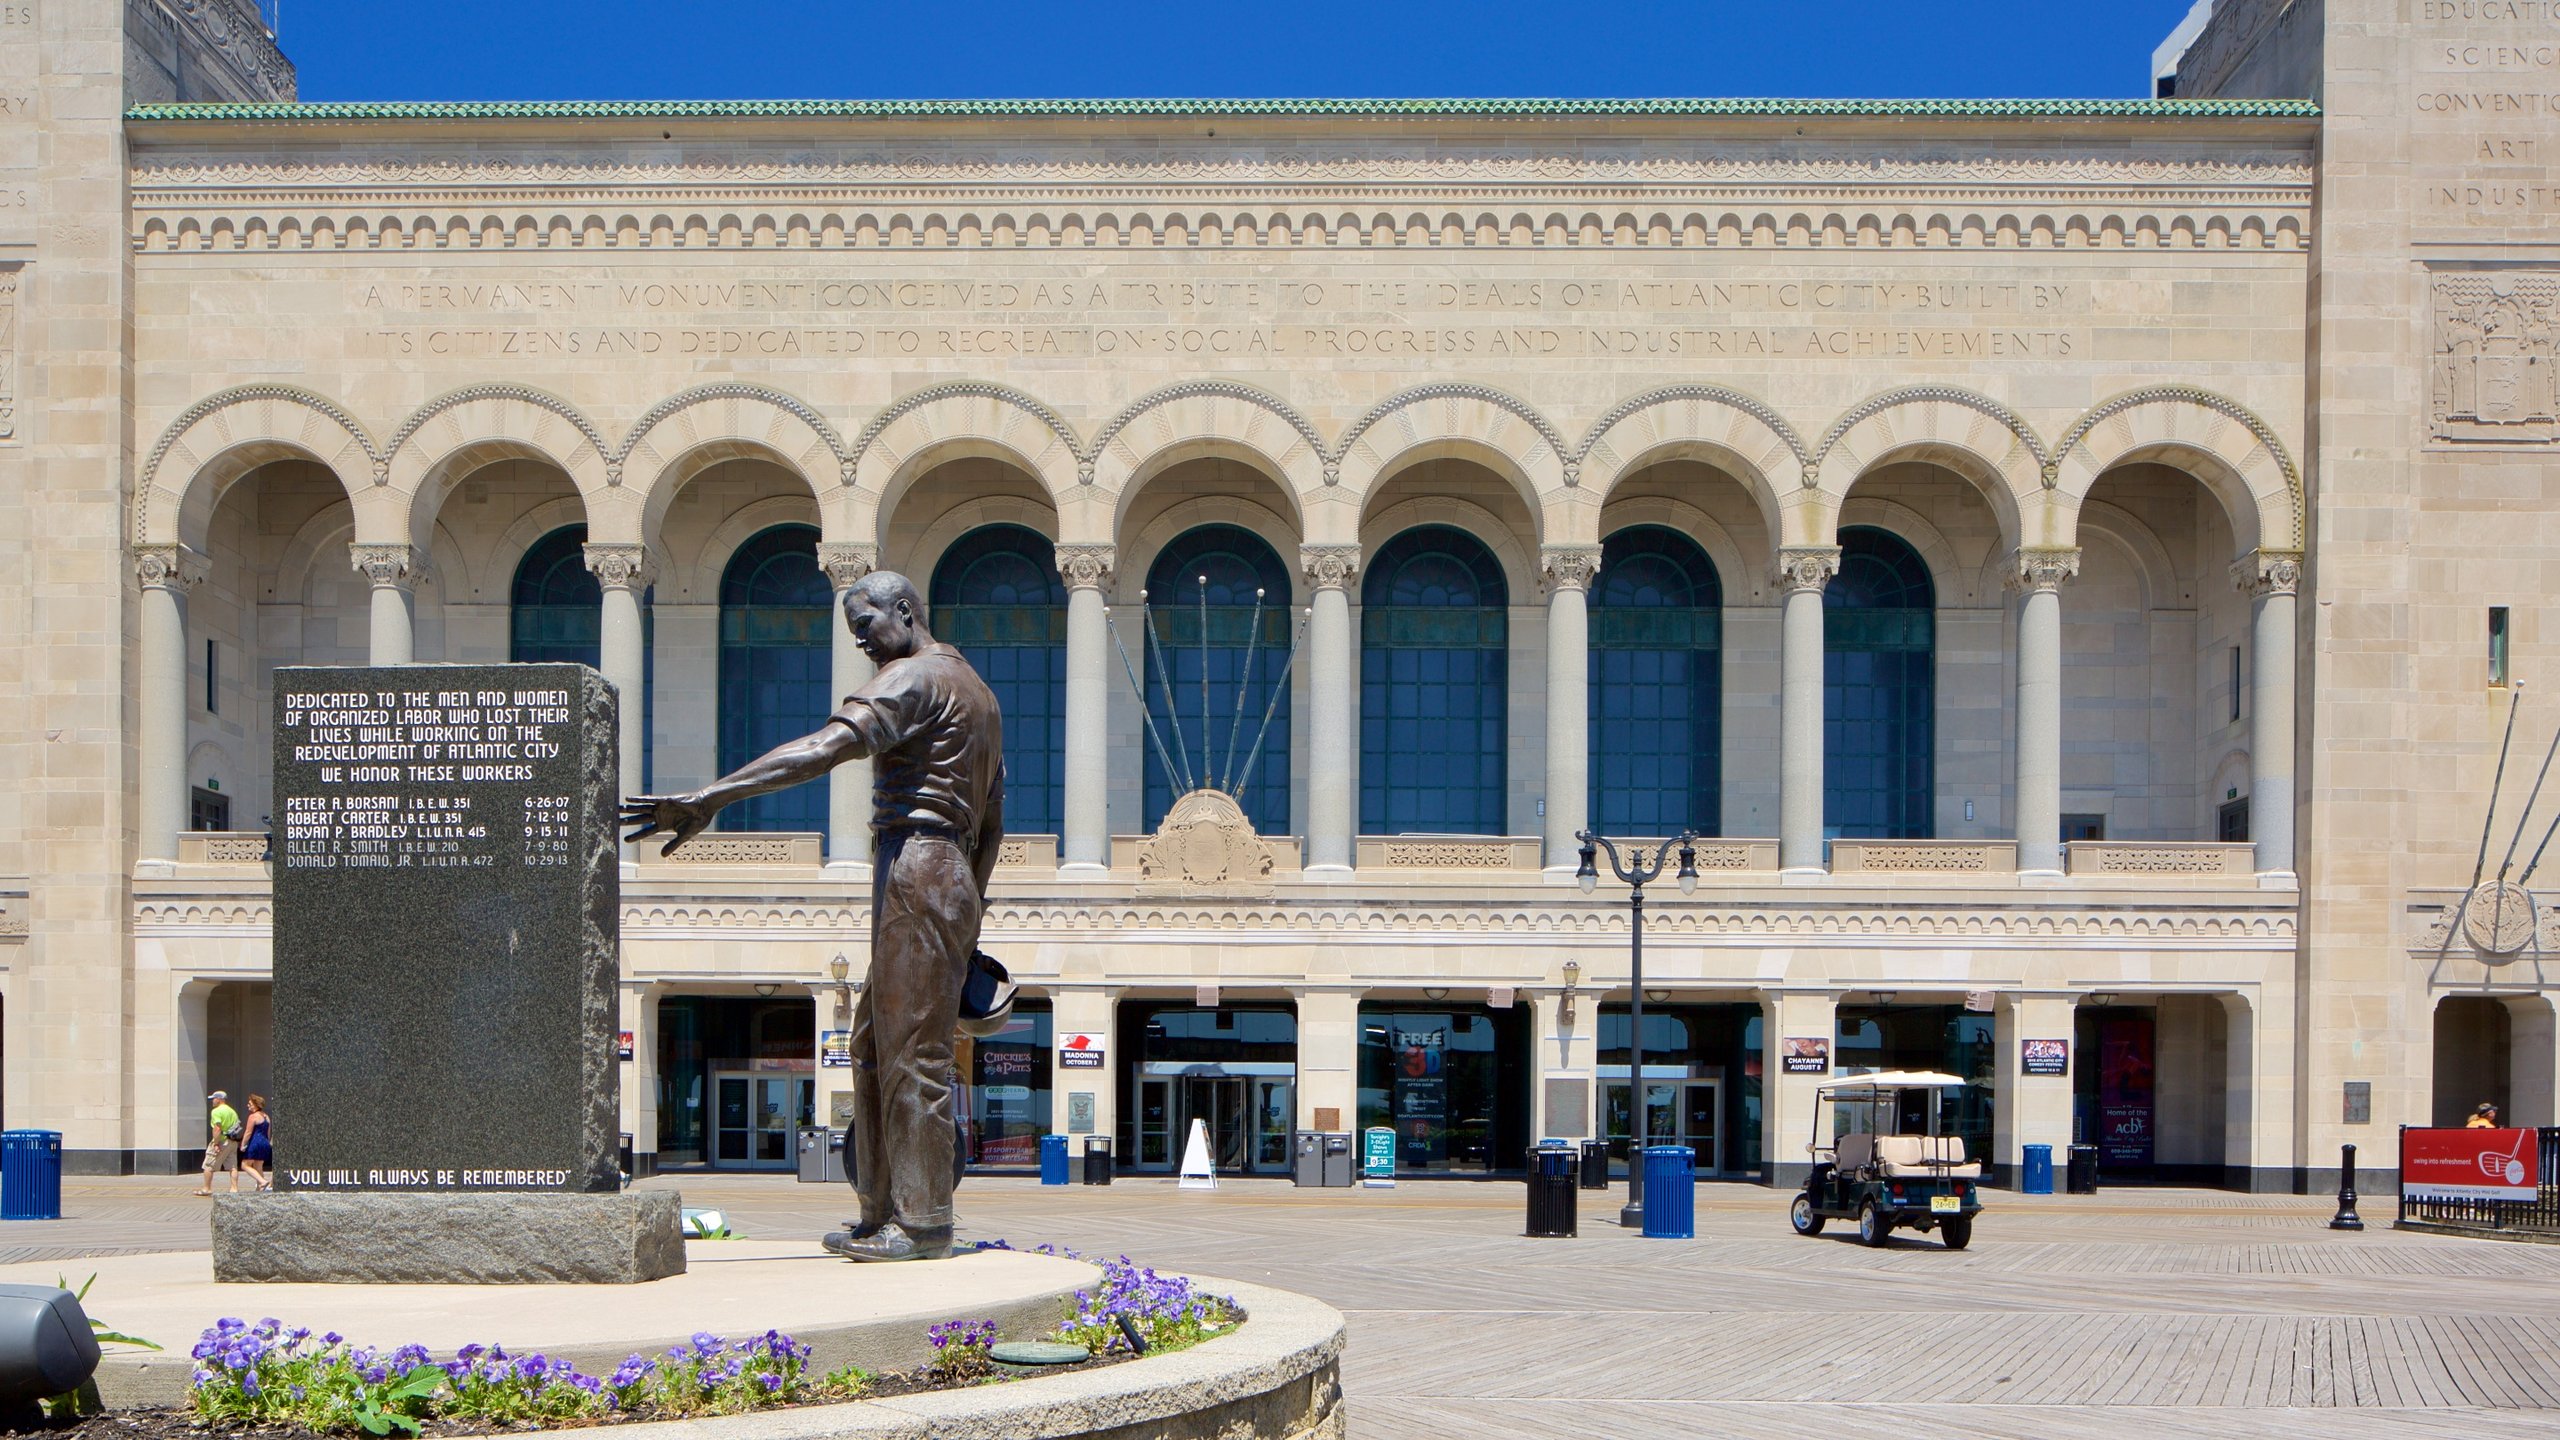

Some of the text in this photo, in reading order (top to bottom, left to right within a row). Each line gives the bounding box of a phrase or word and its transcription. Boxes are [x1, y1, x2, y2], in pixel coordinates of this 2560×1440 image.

[2446, 47, 2560, 65] SCIENC
[2478, 140, 2534, 158] ART
[365, 284, 382, 307] A
[403, 284, 602, 307] PERMANENT
[822, 284, 1020, 307] CONCEIVED
[1033, 284, 1074, 307] AS
[1088, 284, 1109, 307] A
[1122, 284, 1260, 307] TRIBUTE
[1280, 284, 1325, 307] TO
[1343, 284, 1407, 307] THE
[1425, 284, 1543, 307] IDEALS
[1561, 284, 1602, 307] OF
[1619, 284, 1800, 307] ATLANTIC
[1917, 284, 2017, 307] BUILT
[2034, 284, 2070, 307] BY
[365, 330, 412, 355] ITS
[428, 330, 581, 355] CITIZENS
[595, 330, 662, 355] AND
[679, 330, 865, 355] DEDICATED
[876, 330, 921, 355] TO
[1165, 330, 1286, 355] SOCIAL
[1305, 330, 1476, 355] PROGRESS
[1490, 330, 1561, 355] AND
[1578, 330, 1784, 355] INDUSTRIAL
[1805, 330, 2073, 355] ACHIEVEMENTS
[287, 691, 567, 708] DEDICATED TO THE MEN AND WOMEN
[286, 708, 568, 725] OF ORGANIZED LABOR WHO LOST THEIR
[311, 726, 543, 742] LIVES WHILE WORKING ON THE
[296, 743, 558, 760] REDEVELOPMENT OF ATLANTIC CITY
[322, 765, 532, 782] WE HONOR THESE WORKERS
[288, 798, 325, 810] PETER
[333, 797, 342, 809] A.
[347, 797, 398, 809] BORSANI
[454, 798, 469, 808] 351
[287, 812, 334, 824] ROBERT
[341, 812, 389, 824] CARTER
[445, 813, 461, 823] 351
[288, 826, 328, 838] BRYAN
[336, 826, 344, 838] P.
[352, 826, 407, 838] BRADLEY
[469, 827, 485, 837] 415
[288, 841, 325, 853] ALLEN
[334, 841, 342, 853] R.
[351, 841, 387, 853] SMITH
[442, 842, 458, 851] 210
[288, 856, 336, 867] DONALD
[343, 855, 392, 867] TOMAIO,
[397, 855, 413, 866] JR.
[474, 856, 493, 865] 472
[1401, 1033, 1443, 1045] FREE
[1403, 1046, 1441, 1077] 3D
[329, 1170, 361, 1184] WILL
[370, 1170, 428, 1184] ALWAYS
[438, 1170, 455, 1184] BE
